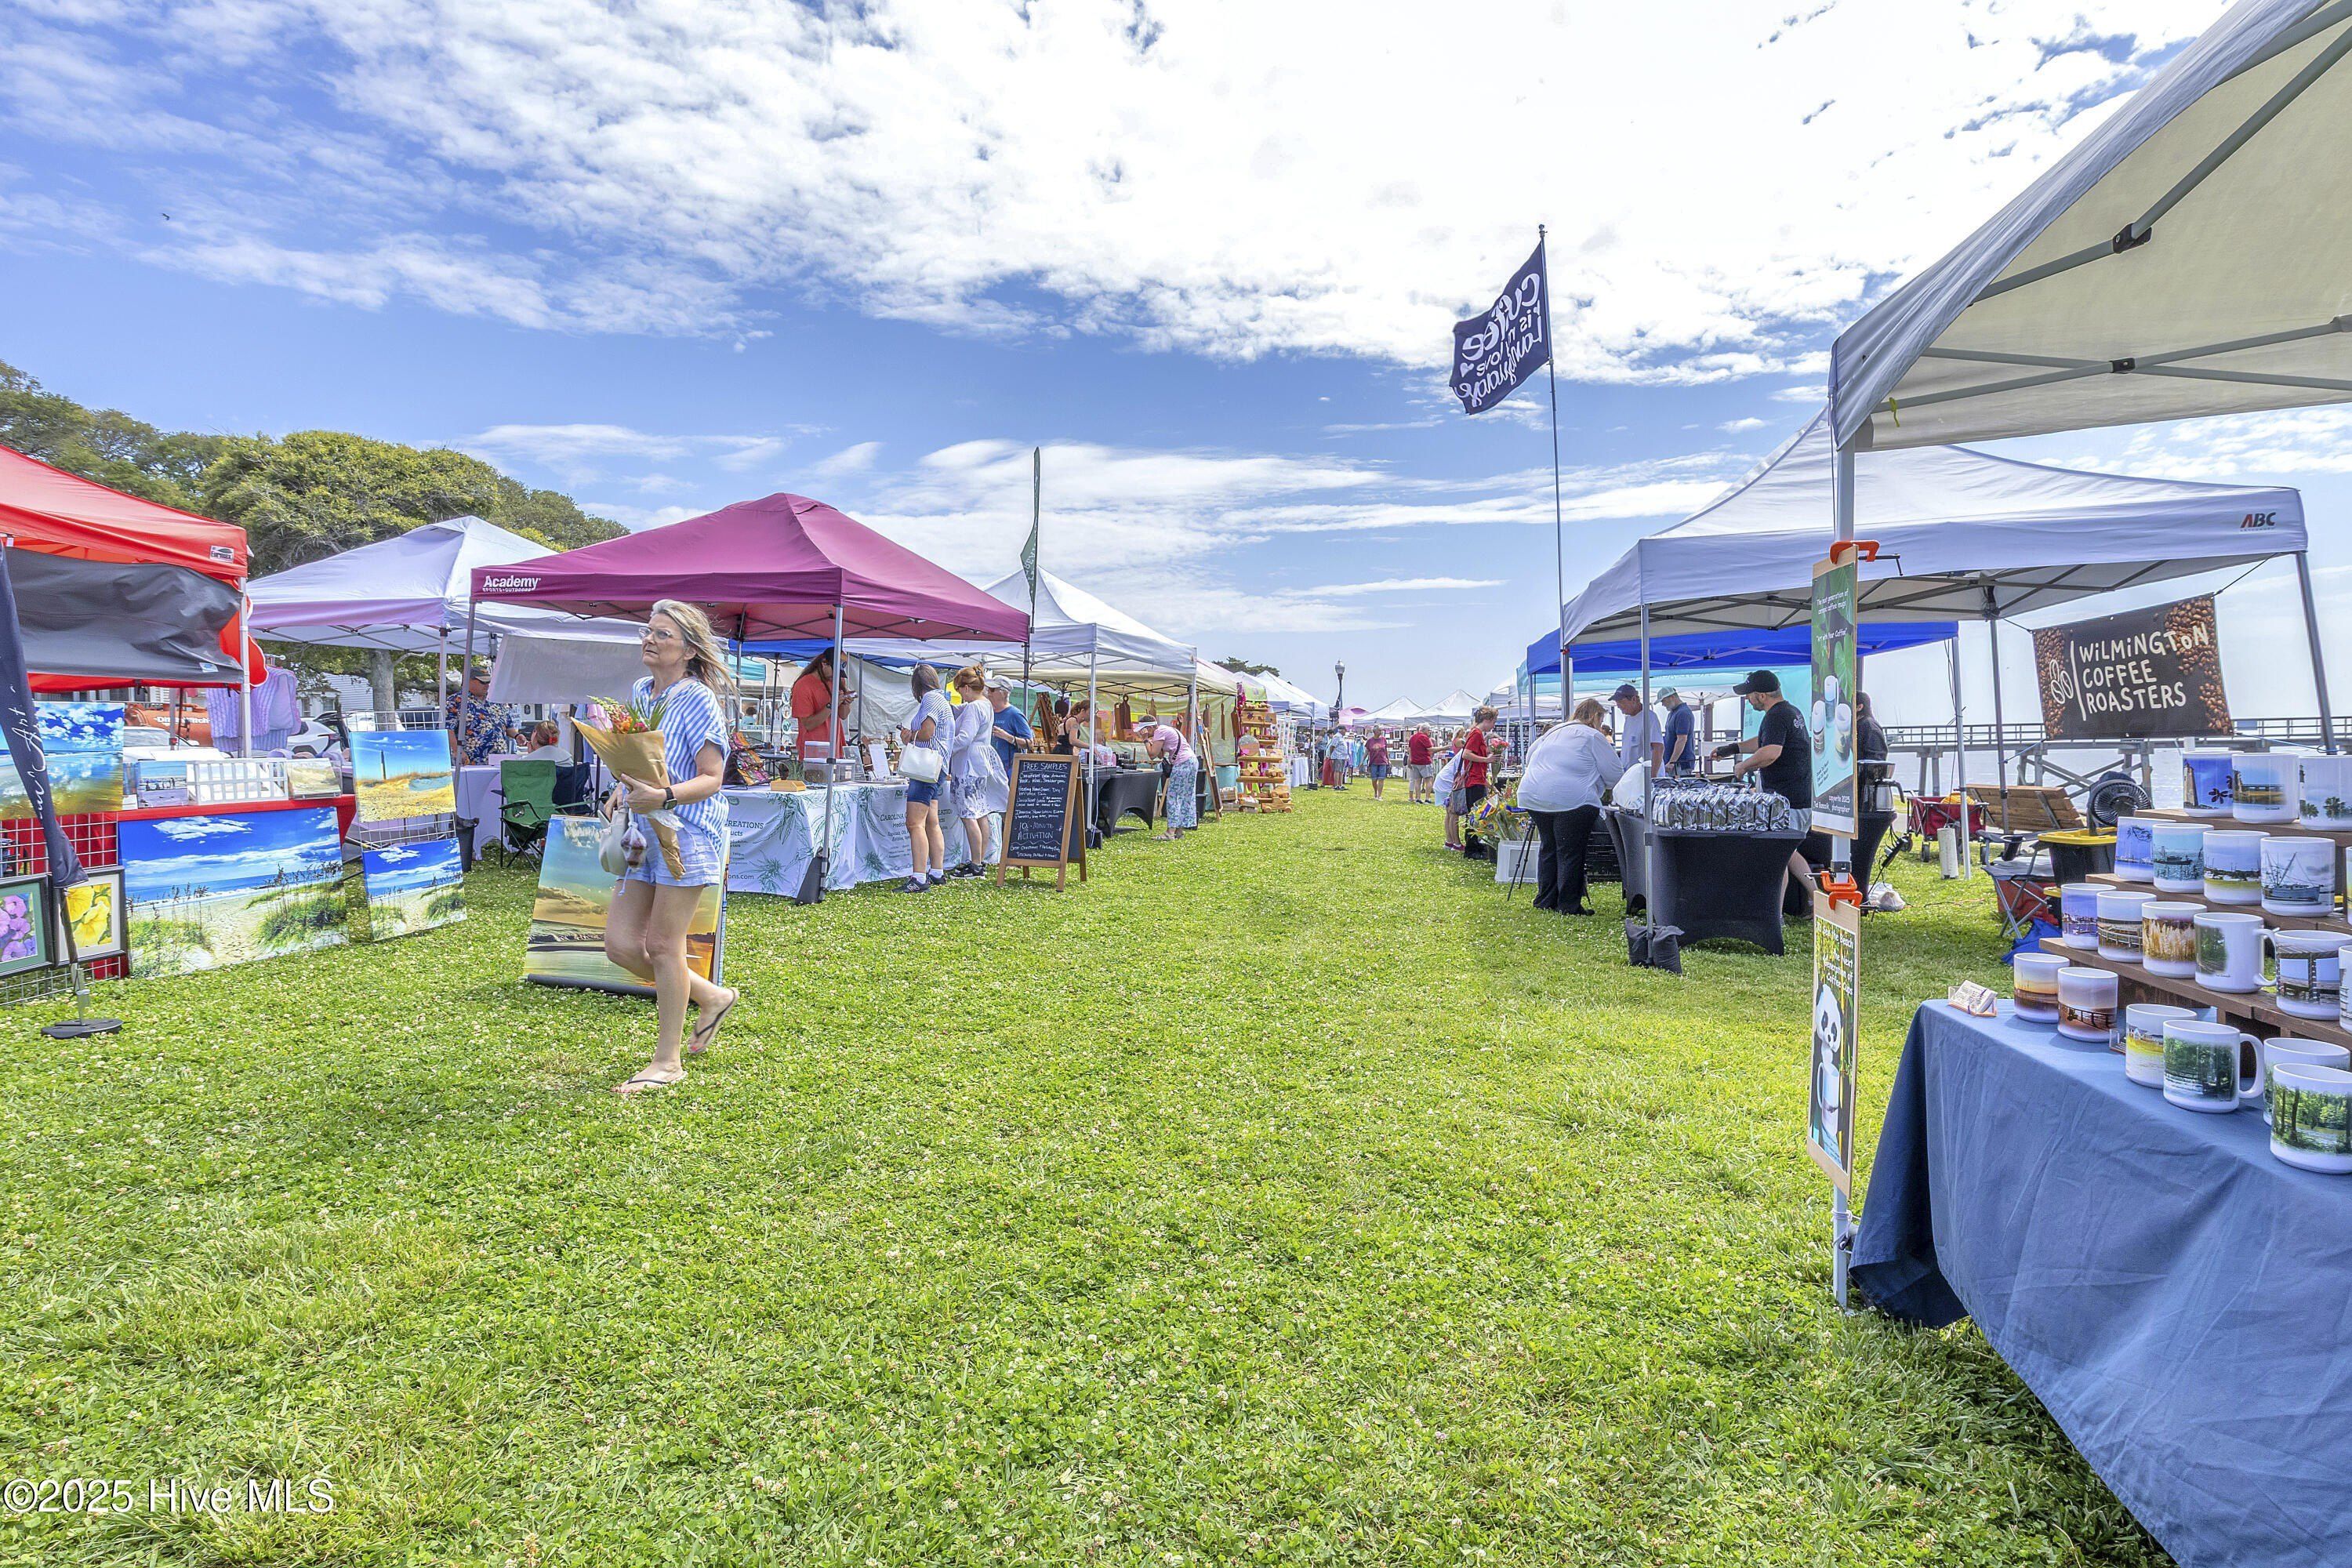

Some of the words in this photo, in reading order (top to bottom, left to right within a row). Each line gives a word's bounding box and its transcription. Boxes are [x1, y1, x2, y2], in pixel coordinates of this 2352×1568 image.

[2240, 512, 2277, 528] ABC
[483, 575, 539, 590] Academy
[2082, 659, 2158, 689] COFFEE
[2085, 681, 2187, 714] ROASTERS
[1022, 761, 1039, 771] FREE
[1040, 762, 1068, 771] SAMPLES
[726, 819, 764, 829] REATIONS
